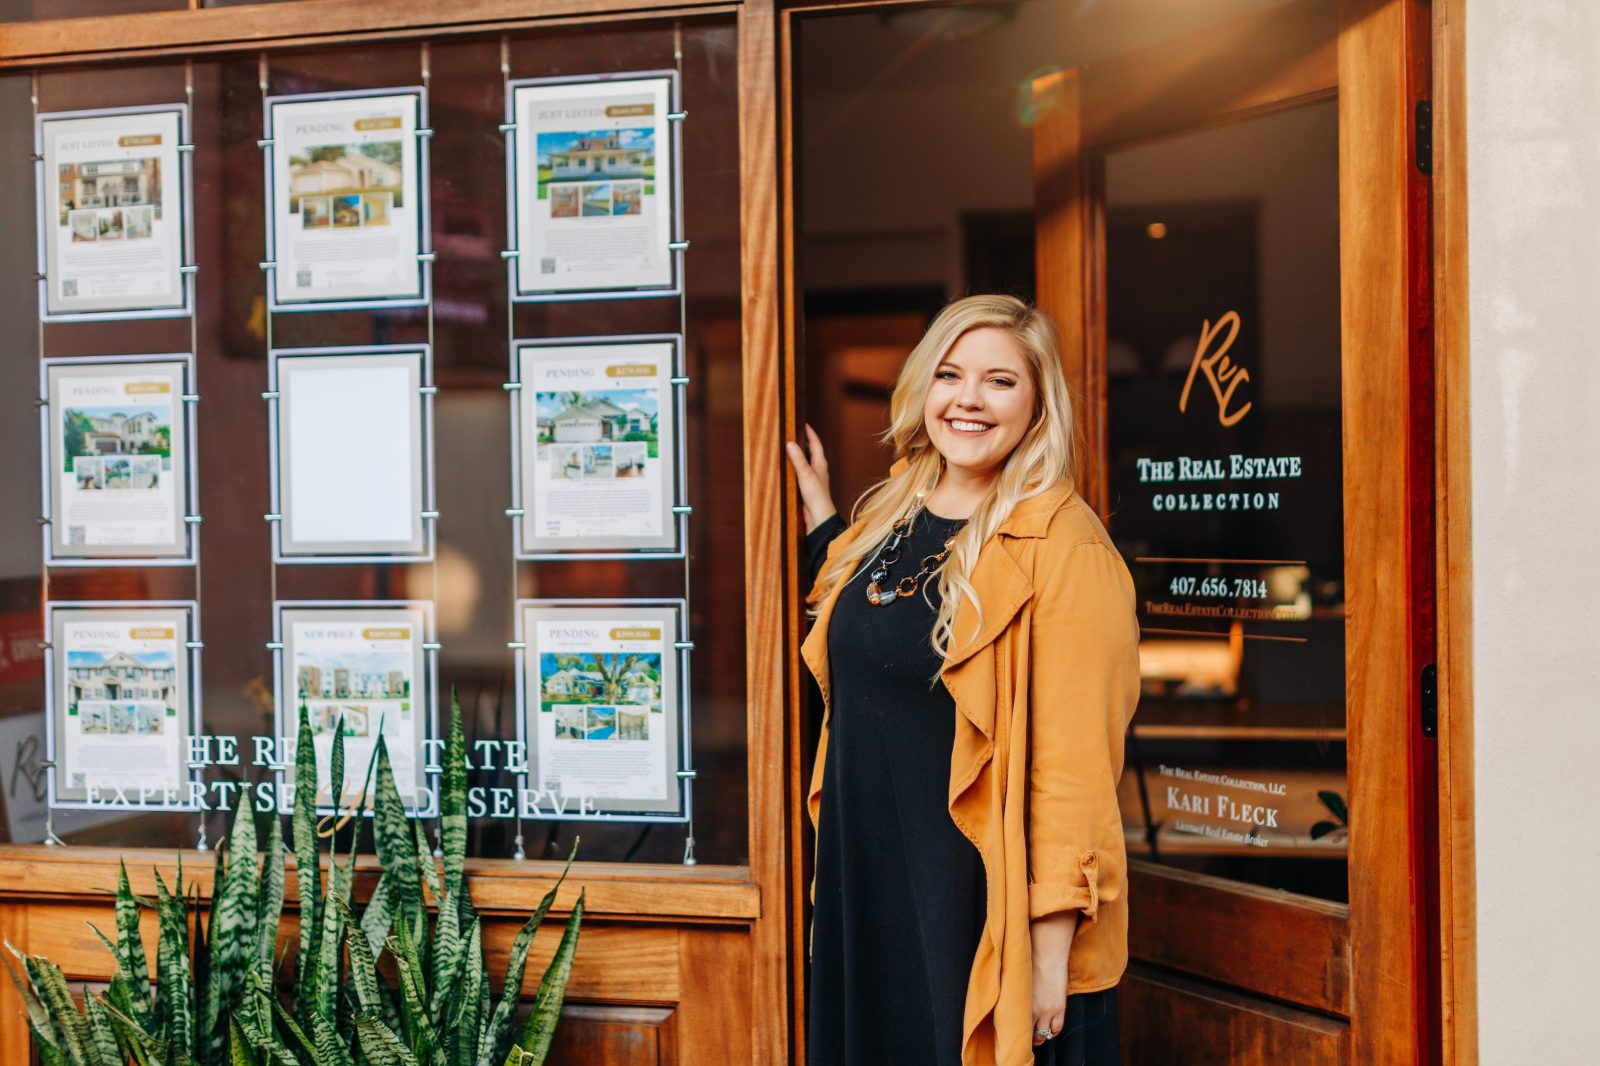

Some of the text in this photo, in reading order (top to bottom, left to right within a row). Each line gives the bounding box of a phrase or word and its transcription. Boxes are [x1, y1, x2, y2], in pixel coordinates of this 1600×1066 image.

[546, 367, 595, 379] PENDING
[1152, 492, 1280, 511] COLLECTION
[1169, 577, 1268, 599] 407.656.7814
[73, 629, 120, 639] PENDING
[549, 628, 599, 639] PENDING
[1268, 782, 1287, 796] LLC
[85, 780, 297, 813] EXPERTSE
[413, 786, 613, 818] DSERVE.
[1166, 786, 1279, 828] KARI FLECK
[1175, 821, 1269, 848] Licensed Real Estate Broker
